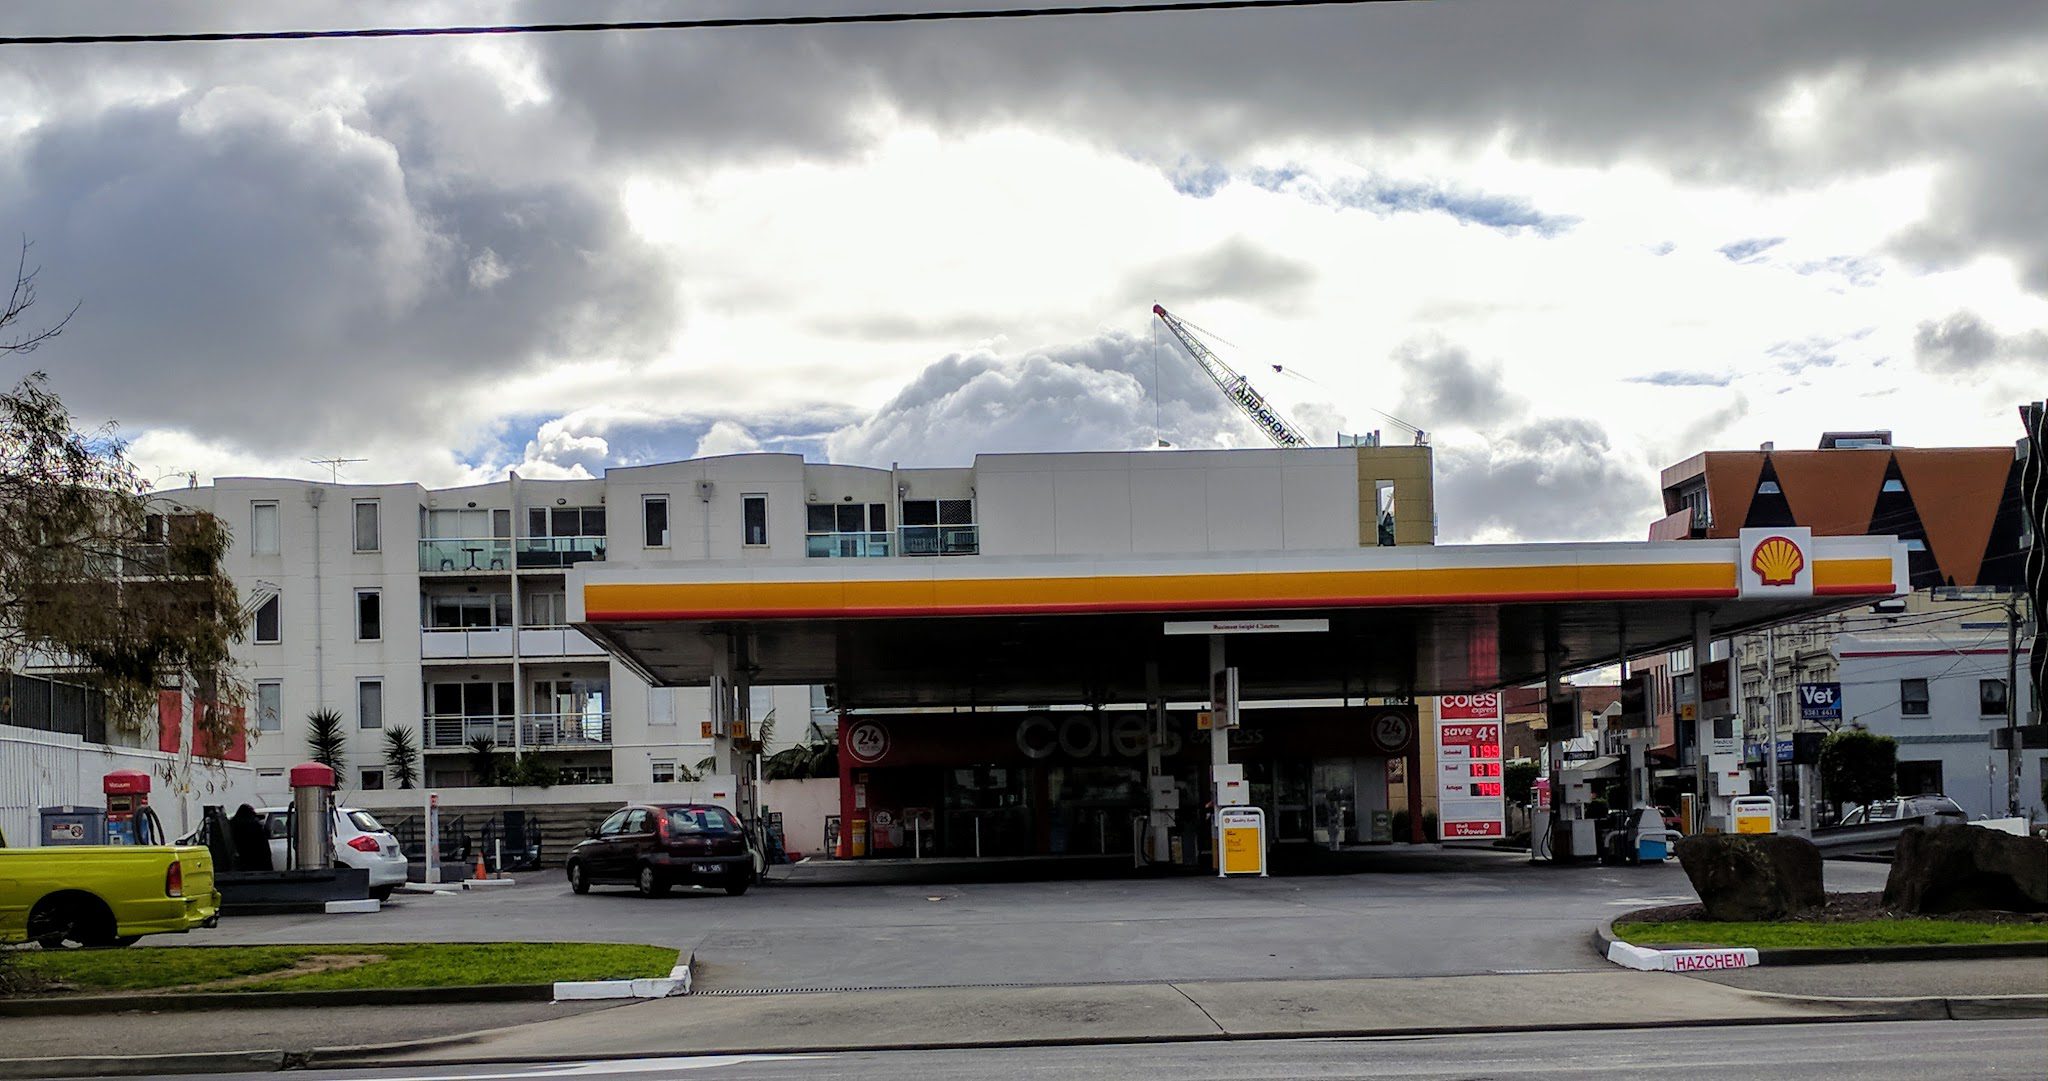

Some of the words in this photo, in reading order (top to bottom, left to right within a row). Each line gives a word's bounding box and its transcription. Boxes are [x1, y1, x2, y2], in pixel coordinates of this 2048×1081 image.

[1260, 409, 1296, 444] GROUP
[1441, 693, 1497, 708] coles
[1801, 686, 1834, 704] Vet
[1471, 706, 1496, 716] express
[1381, 719, 1402, 735] 24
[1443, 727, 1473, 737] save
[858, 729, 880, 745] 24
[1676, 953, 1746, 970] HAZCHEM
